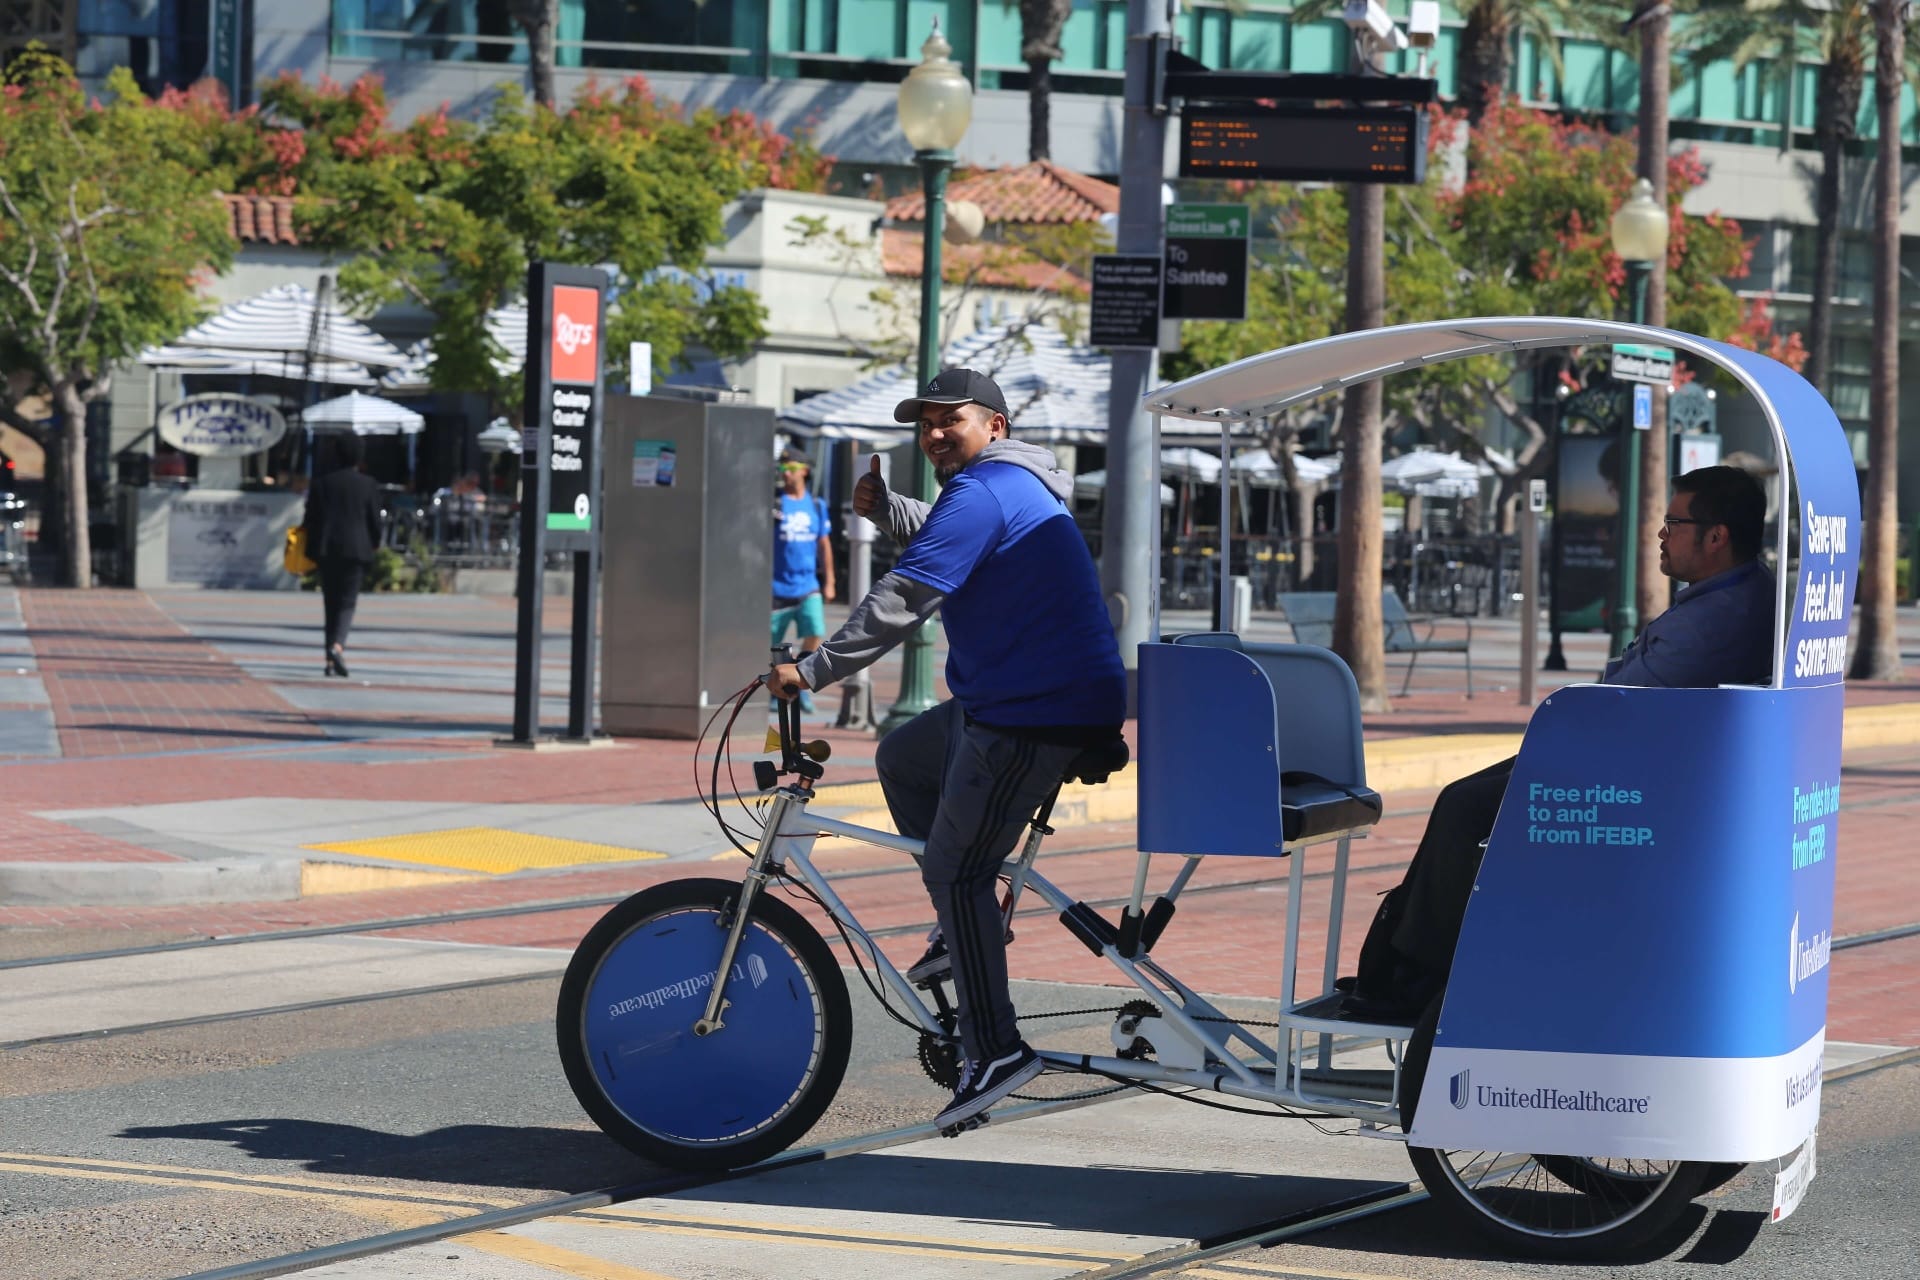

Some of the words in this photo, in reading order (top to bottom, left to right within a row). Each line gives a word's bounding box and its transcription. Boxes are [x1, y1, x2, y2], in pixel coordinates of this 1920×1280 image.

[1168, 245, 1188, 263] To
[1167, 268, 1228, 286] Santee
[174, 399, 211, 425] TIN
[221, 399, 272, 431] FISH
[552, 434, 581, 455] Trolley
[551, 453, 582, 471] Station
[1807, 500, 1829, 554] Save
[1829, 515, 1847, 565] your
[1803, 570, 1826, 623] feet.
[1827, 570, 1845, 620] And
[1795, 637, 1827, 678] some
[1529, 783, 1580, 802] Free
[1585, 784, 1642, 804] rides
[1793, 786, 1808, 825] Free
[1809, 781, 1823, 821] rides
[1528, 804, 1551, 822] to
[1556, 804, 1598, 823] and
[1528, 825, 1580, 843] from
[1585, 826, 1655, 846] IFEBP.
[1792, 832, 1808, 871] from
[608, 963, 746, 1018] UtedHealthcare
[1477, 1086, 1649, 1113] UnitedHealthcare
